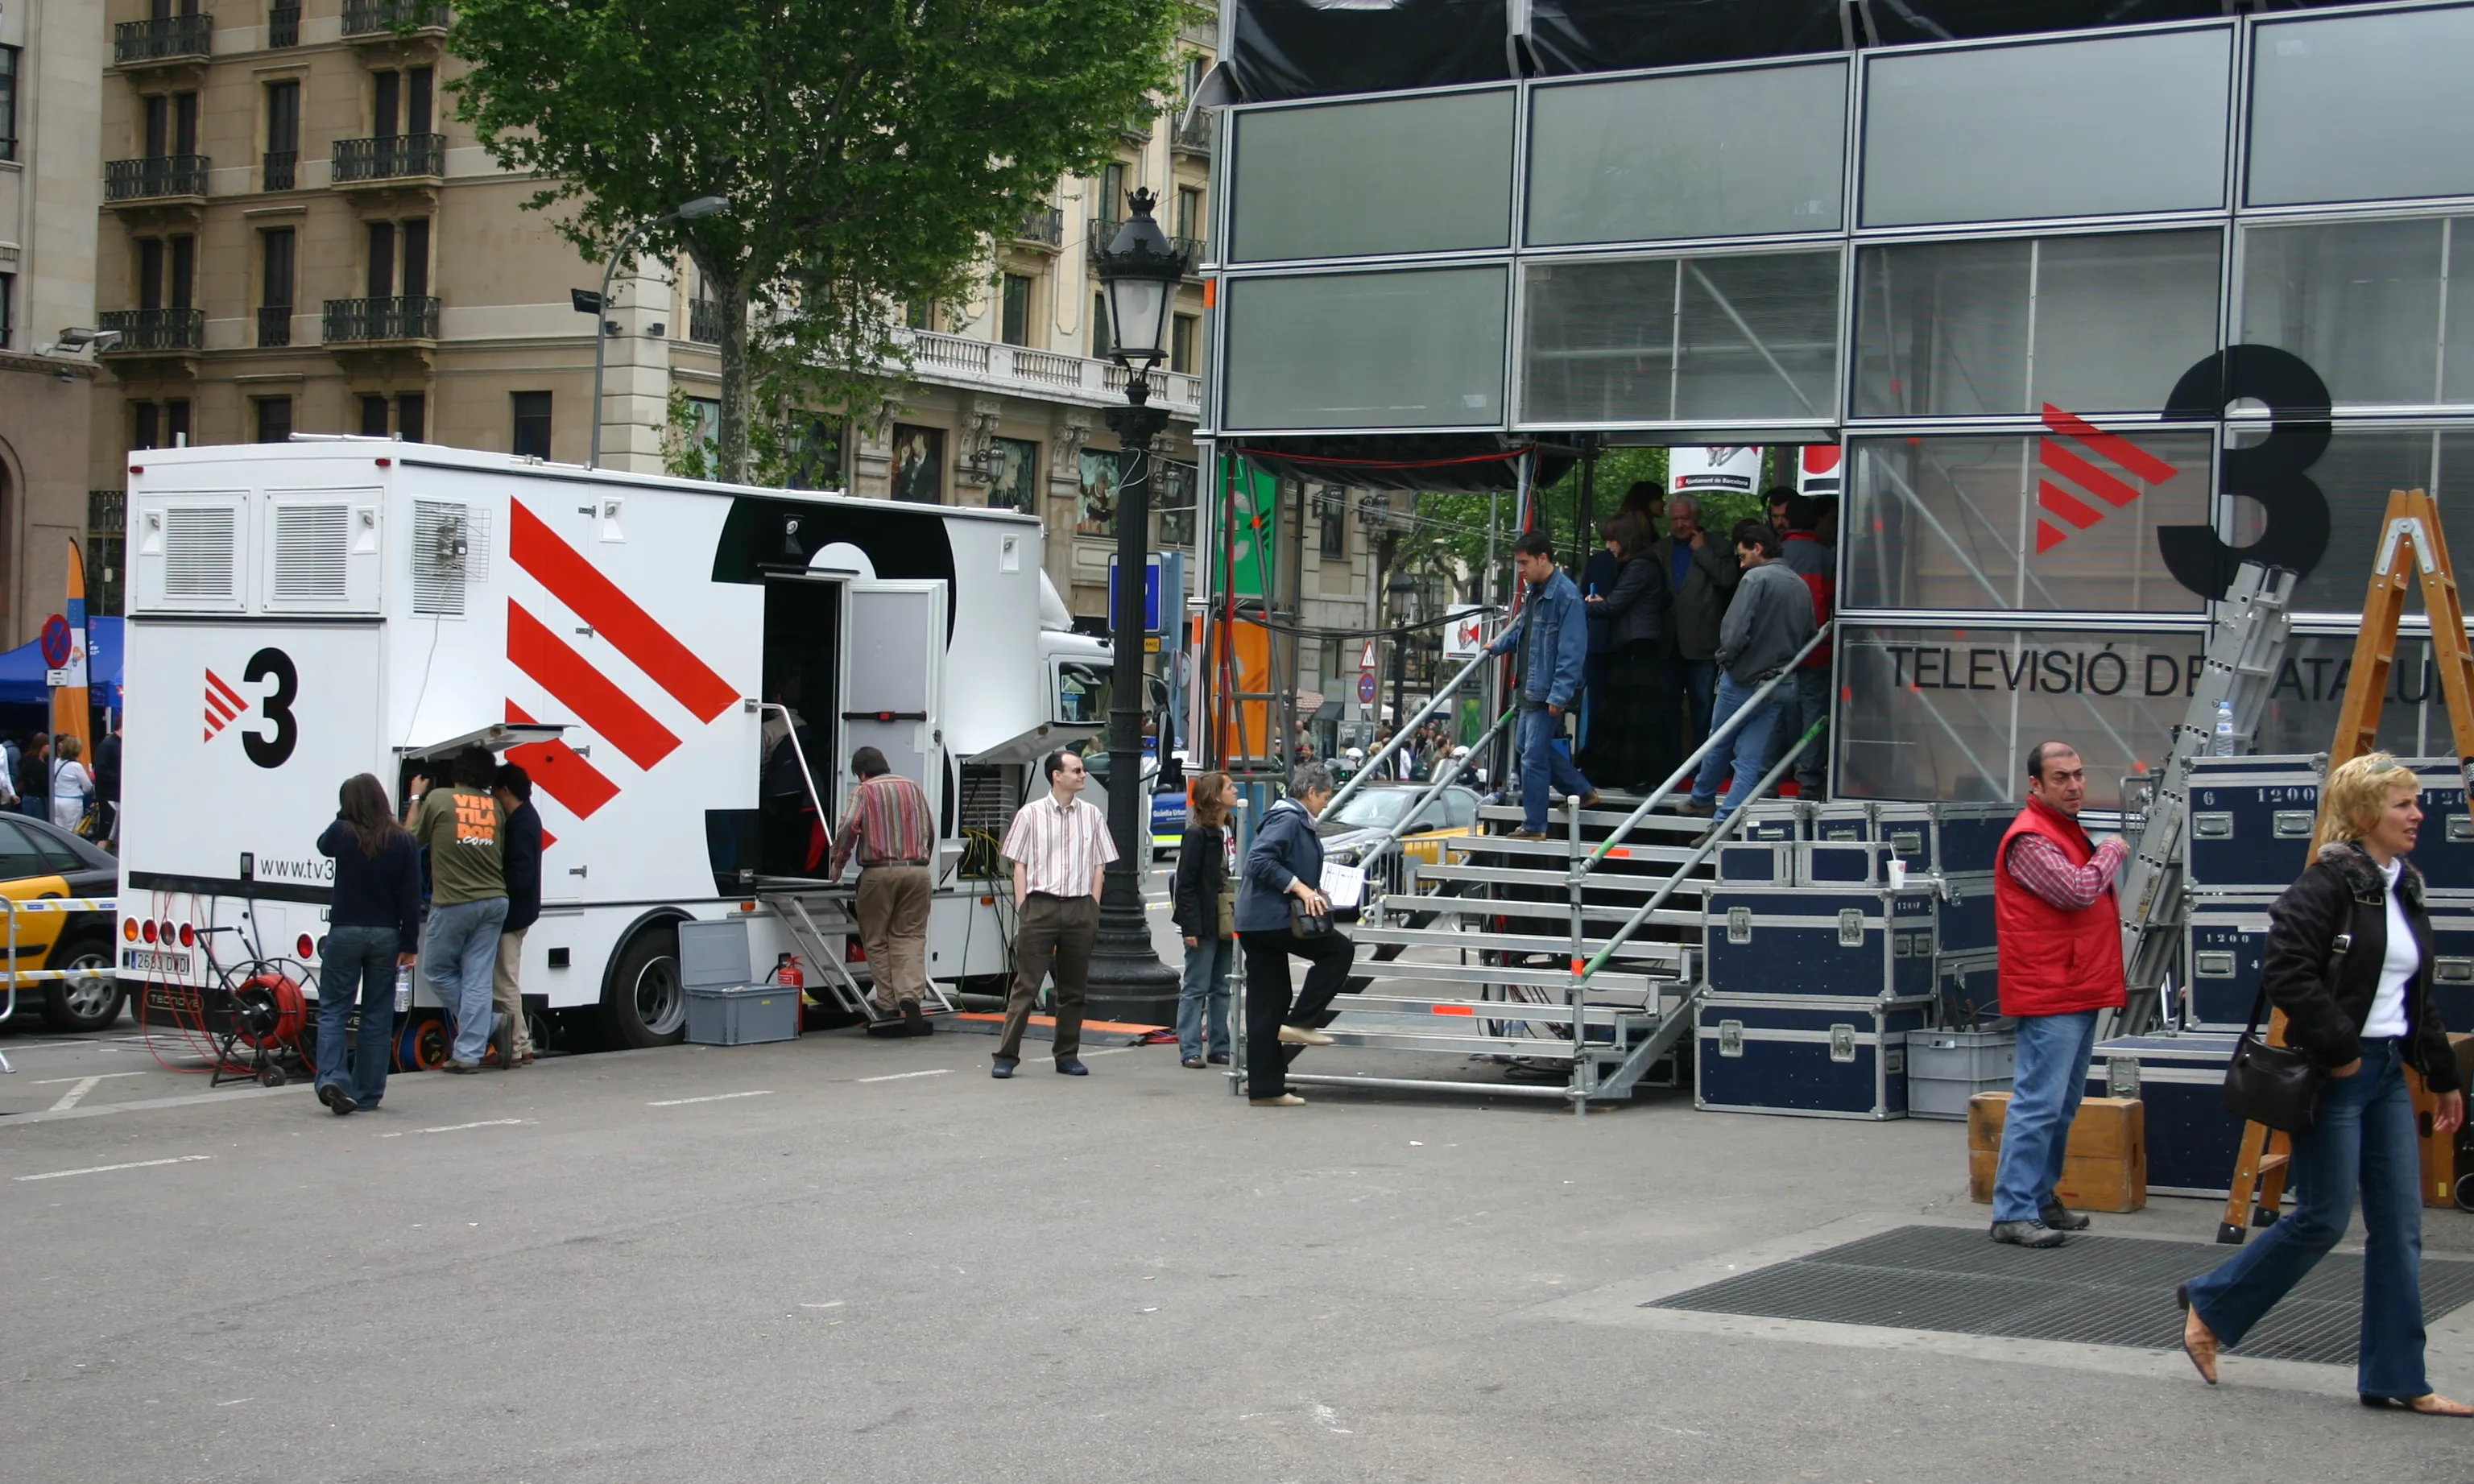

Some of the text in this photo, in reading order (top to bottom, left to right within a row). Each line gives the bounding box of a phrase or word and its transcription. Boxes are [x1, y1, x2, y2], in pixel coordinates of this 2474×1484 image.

[1722, 477, 1749, 486] Barcelona
[2157, 344, 2332, 602] 3
[1886, 643, 2127, 696] TELEVISIÓ
[242, 647, 298, 768] 3
[453, 794, 494, 810] VEN
[2203, 787, 2315, 805] 6 1200
[455, 808, 497, 826] TILA
[2206, 933, 2249, 943] 1200
